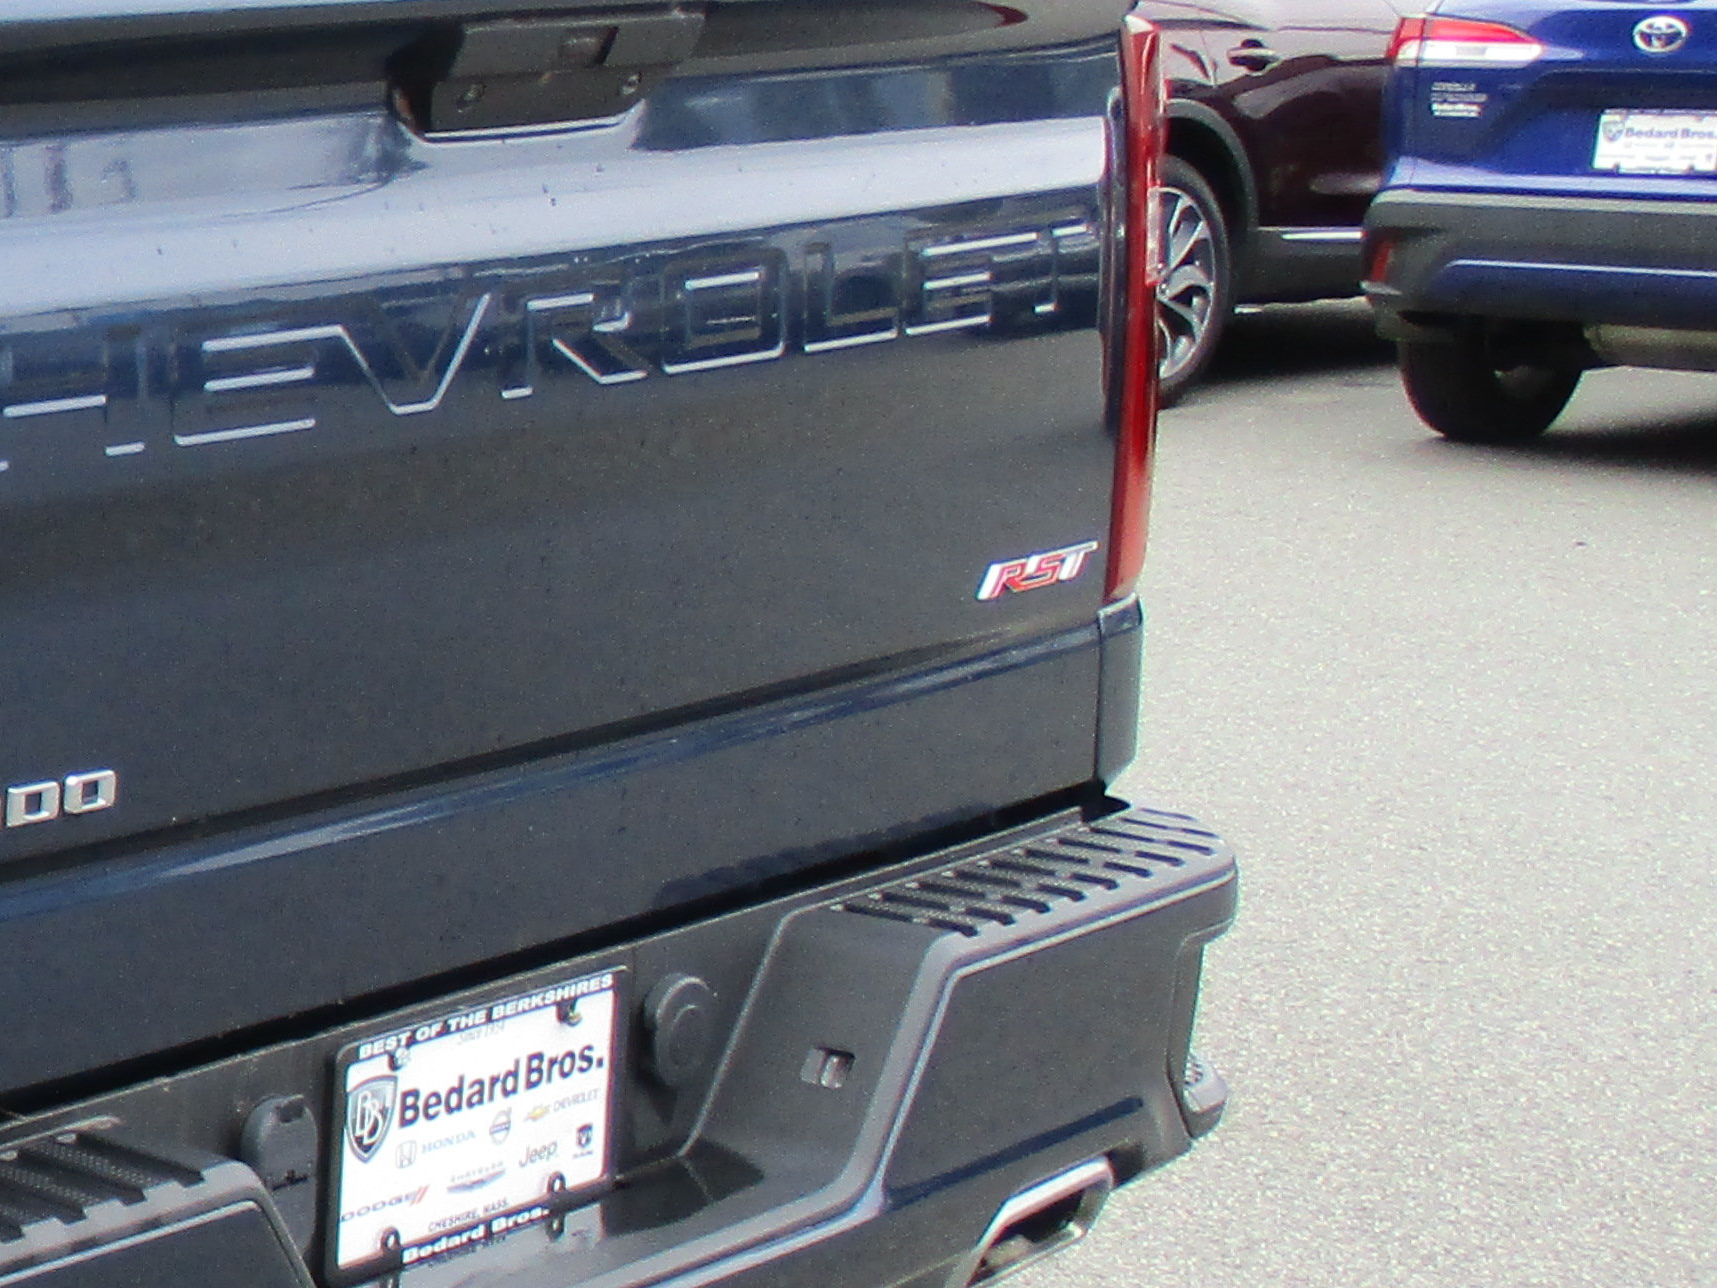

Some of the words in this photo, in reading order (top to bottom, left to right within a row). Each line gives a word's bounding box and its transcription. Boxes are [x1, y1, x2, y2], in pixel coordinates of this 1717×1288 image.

[975, 540, 1100, 600] RST
[358, 1028, 413, 1060] BEST
[415, 1022, 441, 1042] OF
[447, 1007, 487, 1033] THE
[491, 973, 614, 1020] BERKSHIRES
[421, 1129, 477, 1155] HONDA
[518, 1140, 558, 1168] Jeep
[402, 1224, 486, 1265] Bedard
[490, 1206, 550, 1235] Bros.
